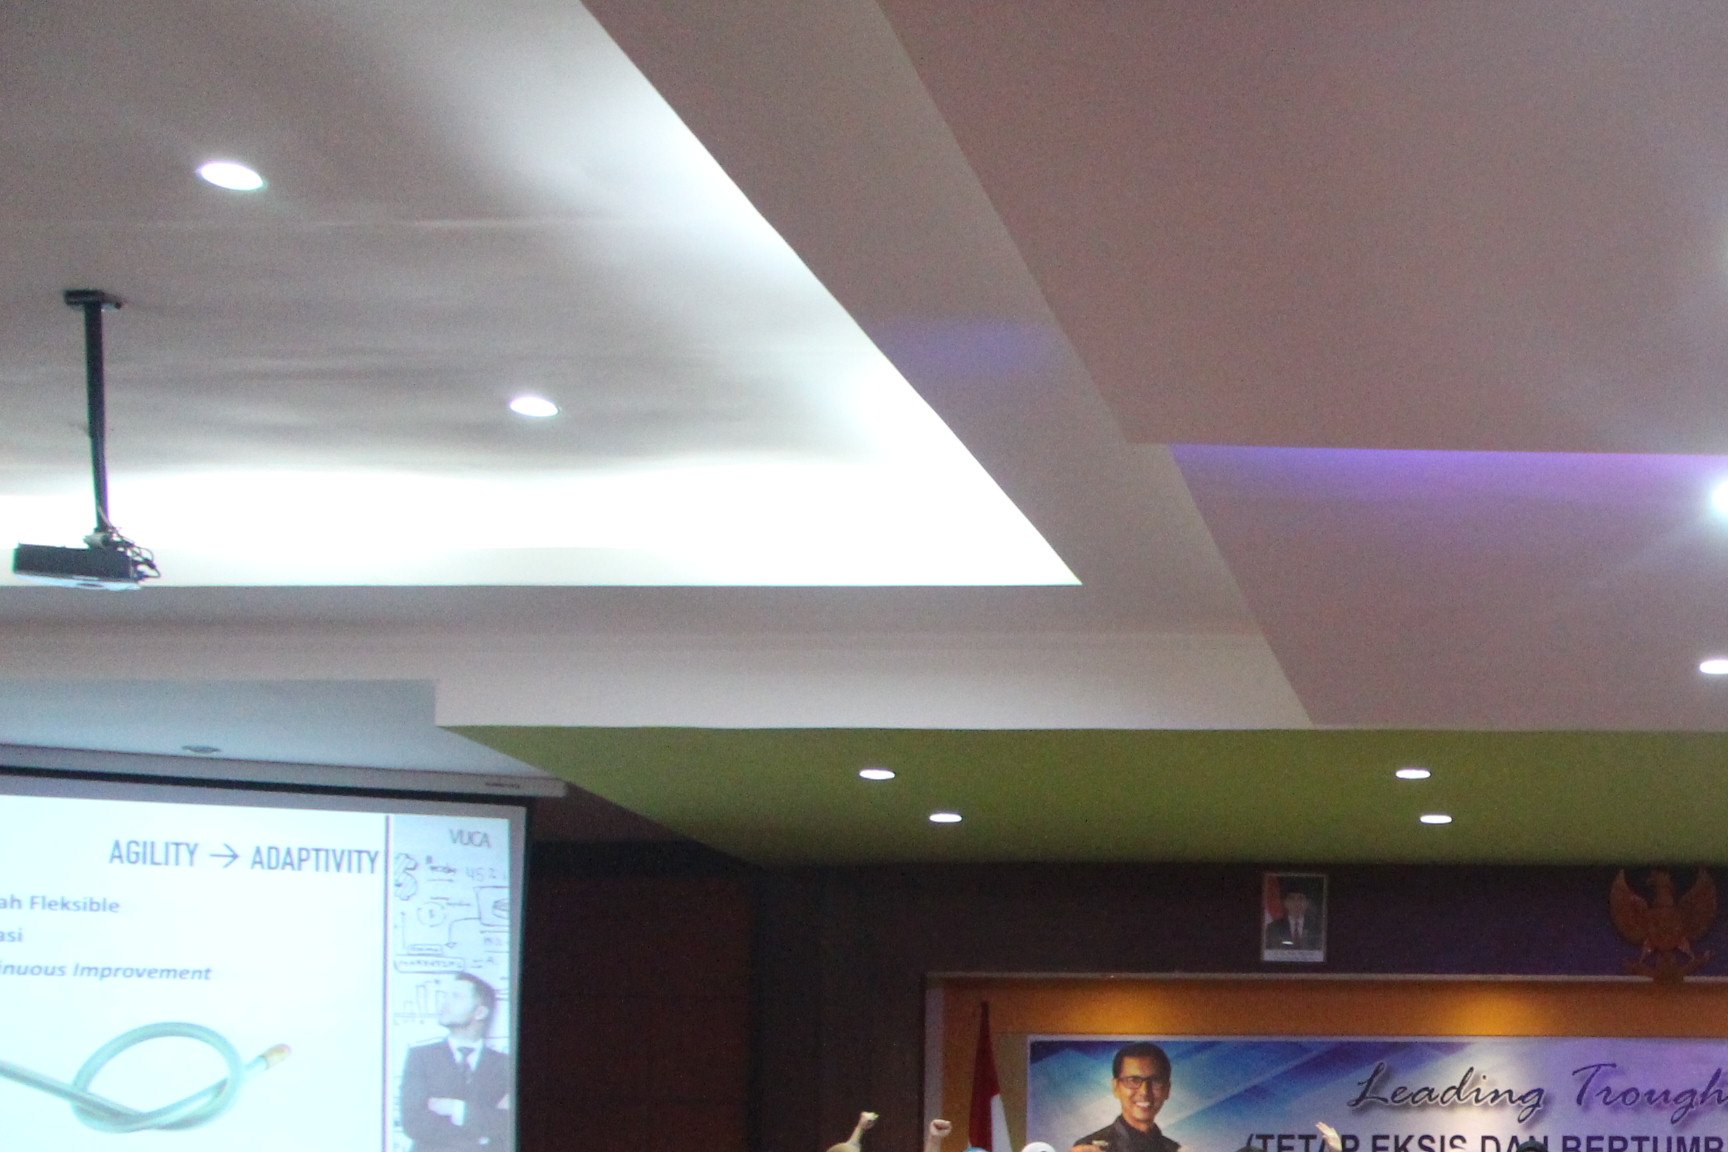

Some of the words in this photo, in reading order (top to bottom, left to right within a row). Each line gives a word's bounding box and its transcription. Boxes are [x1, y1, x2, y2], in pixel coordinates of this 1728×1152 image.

[449, 828, 492, 848] VUCA
[109, 839, 199, 867] AGILITY
[251, 845, 379, 874] ADAPTIVITY
[30, 895, 120, 913] Fleksible
[73, 962, 211, 981] Improvement
[1348, 1061, 1545, 1122] Leading
